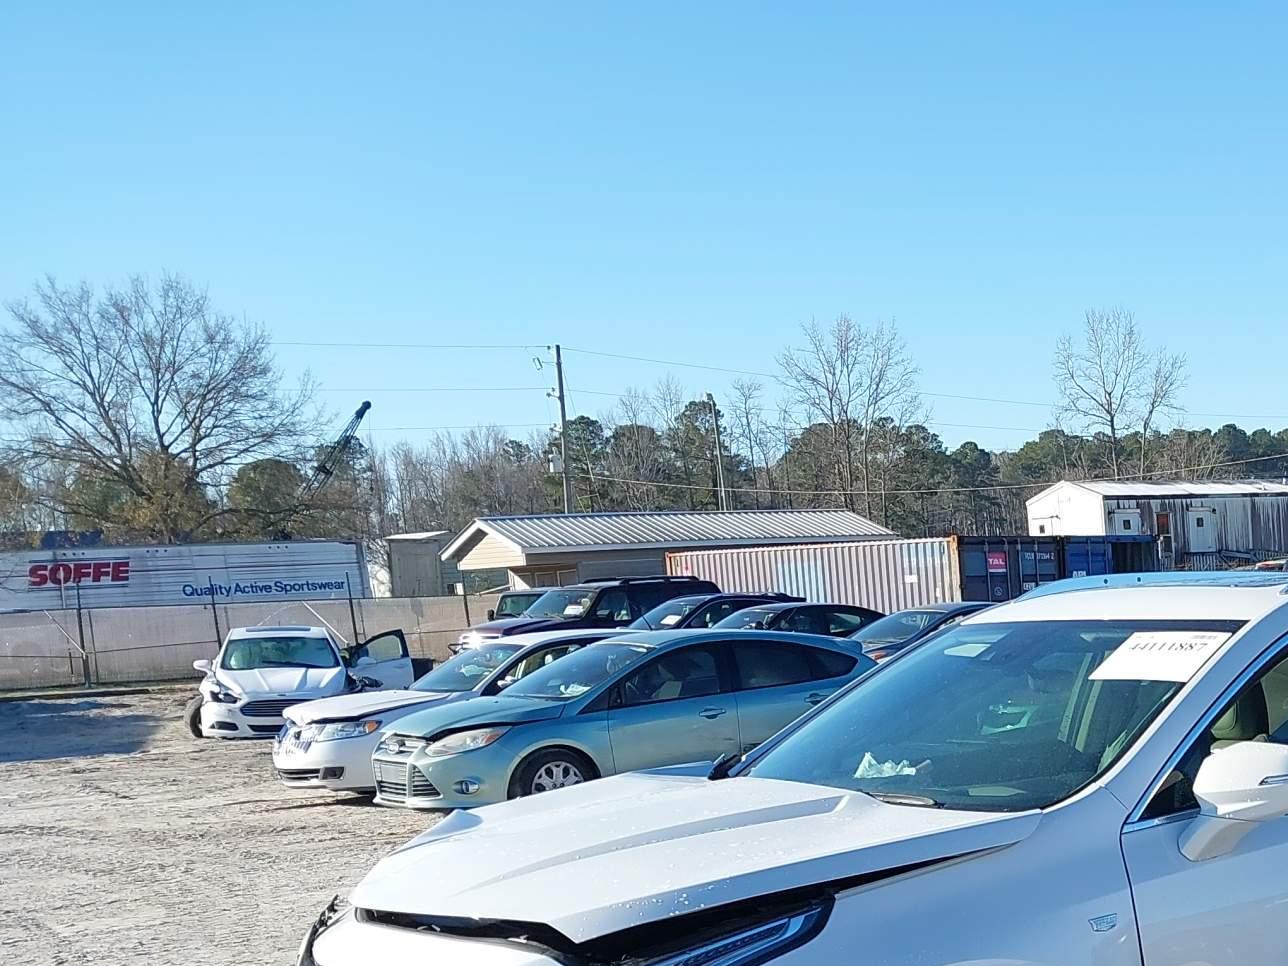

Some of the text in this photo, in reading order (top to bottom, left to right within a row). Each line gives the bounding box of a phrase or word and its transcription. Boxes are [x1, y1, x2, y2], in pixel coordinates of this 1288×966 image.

[28, 561, 130, 587] SOFFE
[182, 580, 345, 598] Quality Active Sportswear
